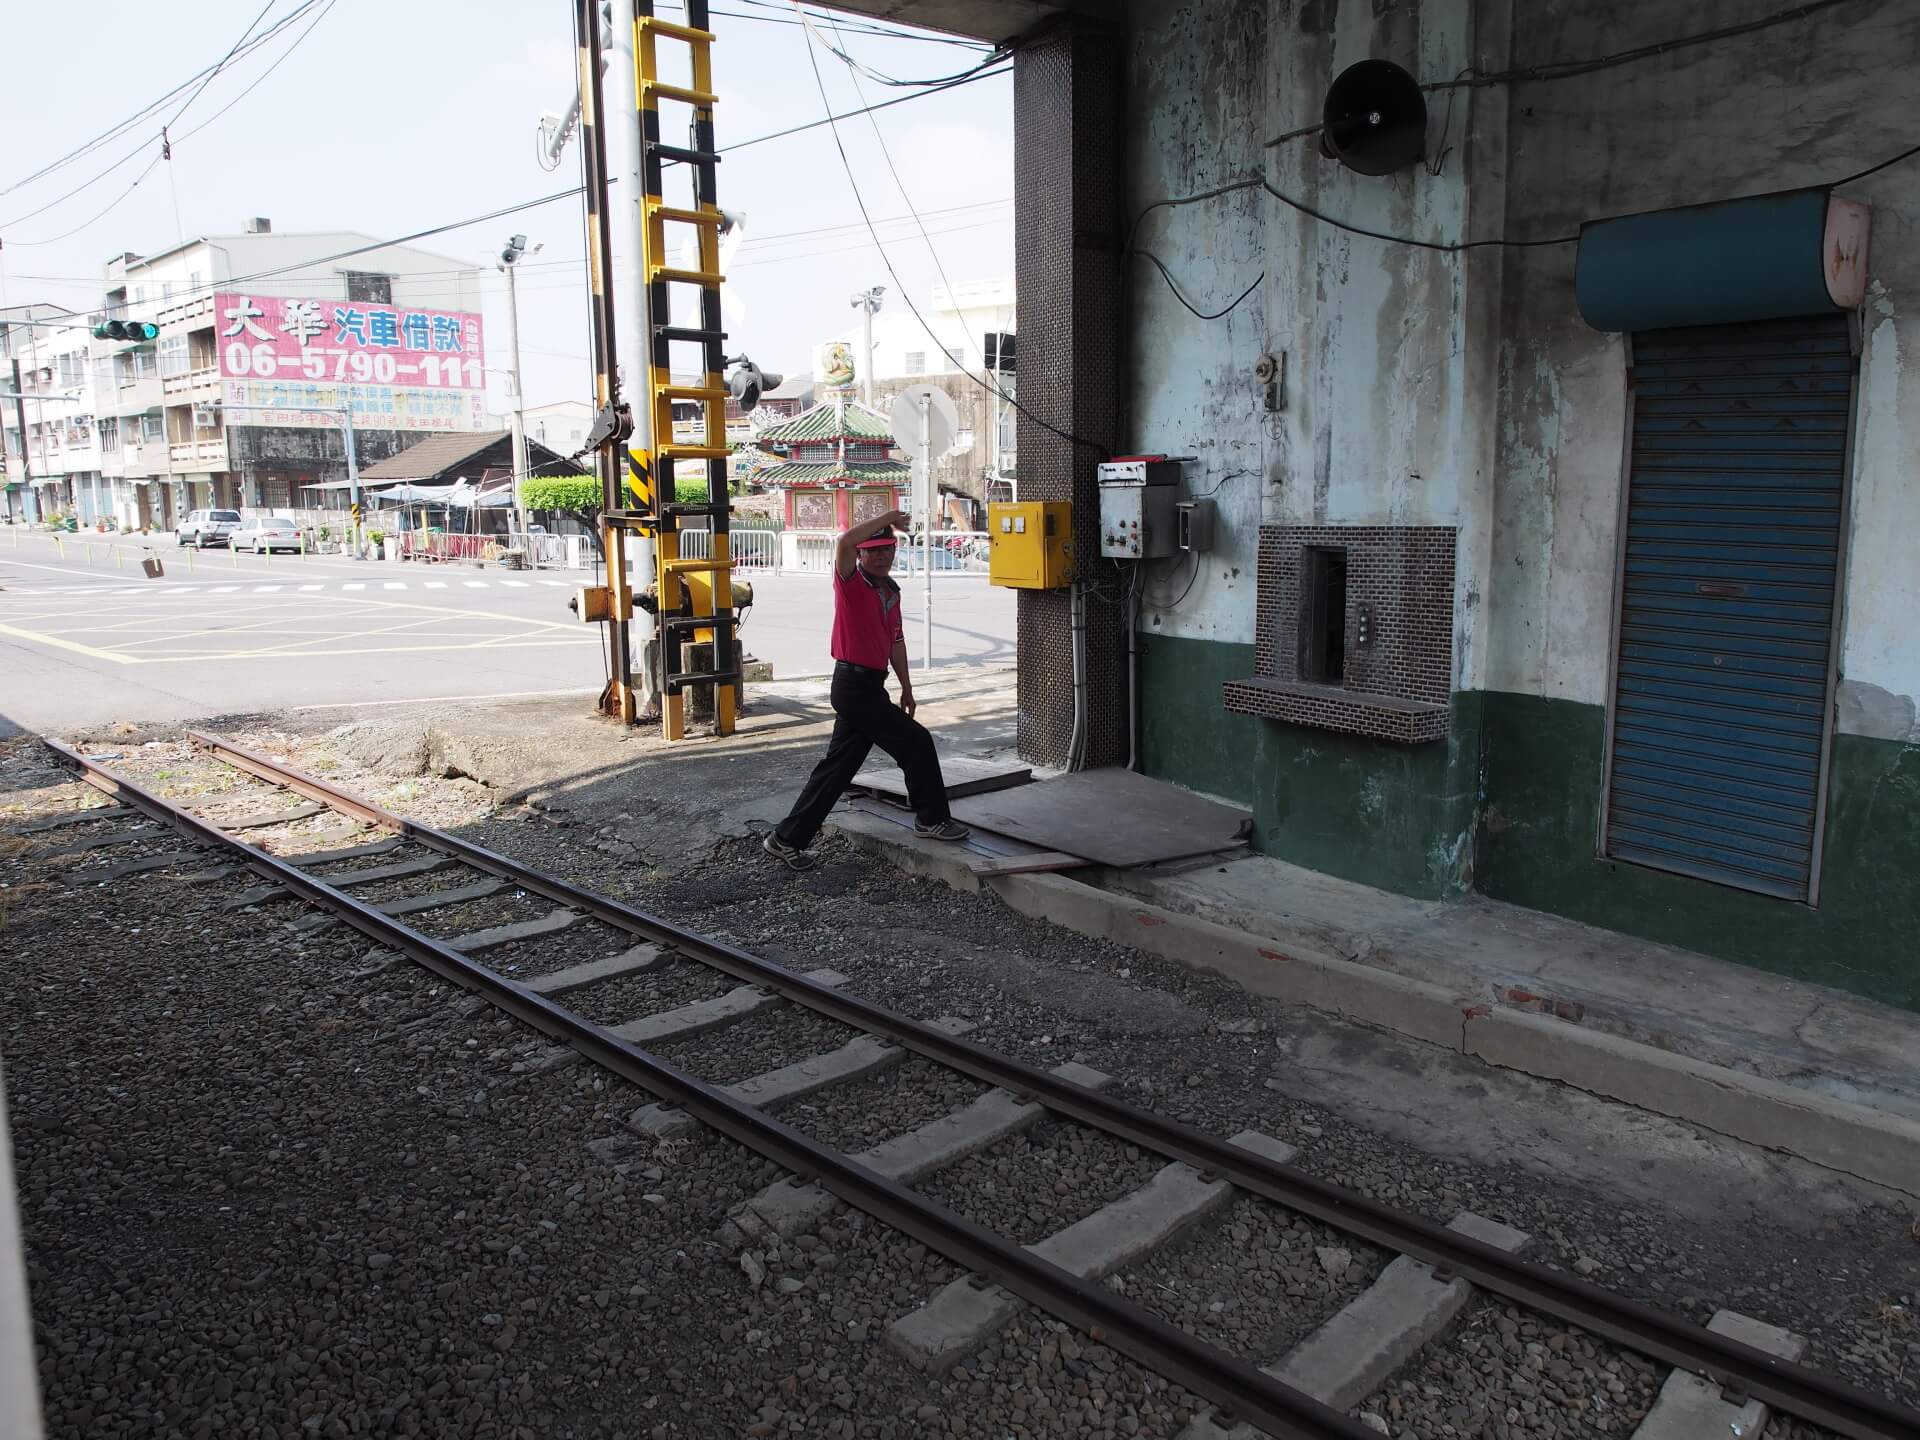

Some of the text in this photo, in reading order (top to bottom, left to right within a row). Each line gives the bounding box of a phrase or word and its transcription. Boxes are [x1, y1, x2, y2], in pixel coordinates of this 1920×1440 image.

[223, 296, 464, 353] 大華 汽車借款
[225, 342, 482, 387] 06-5790-111
